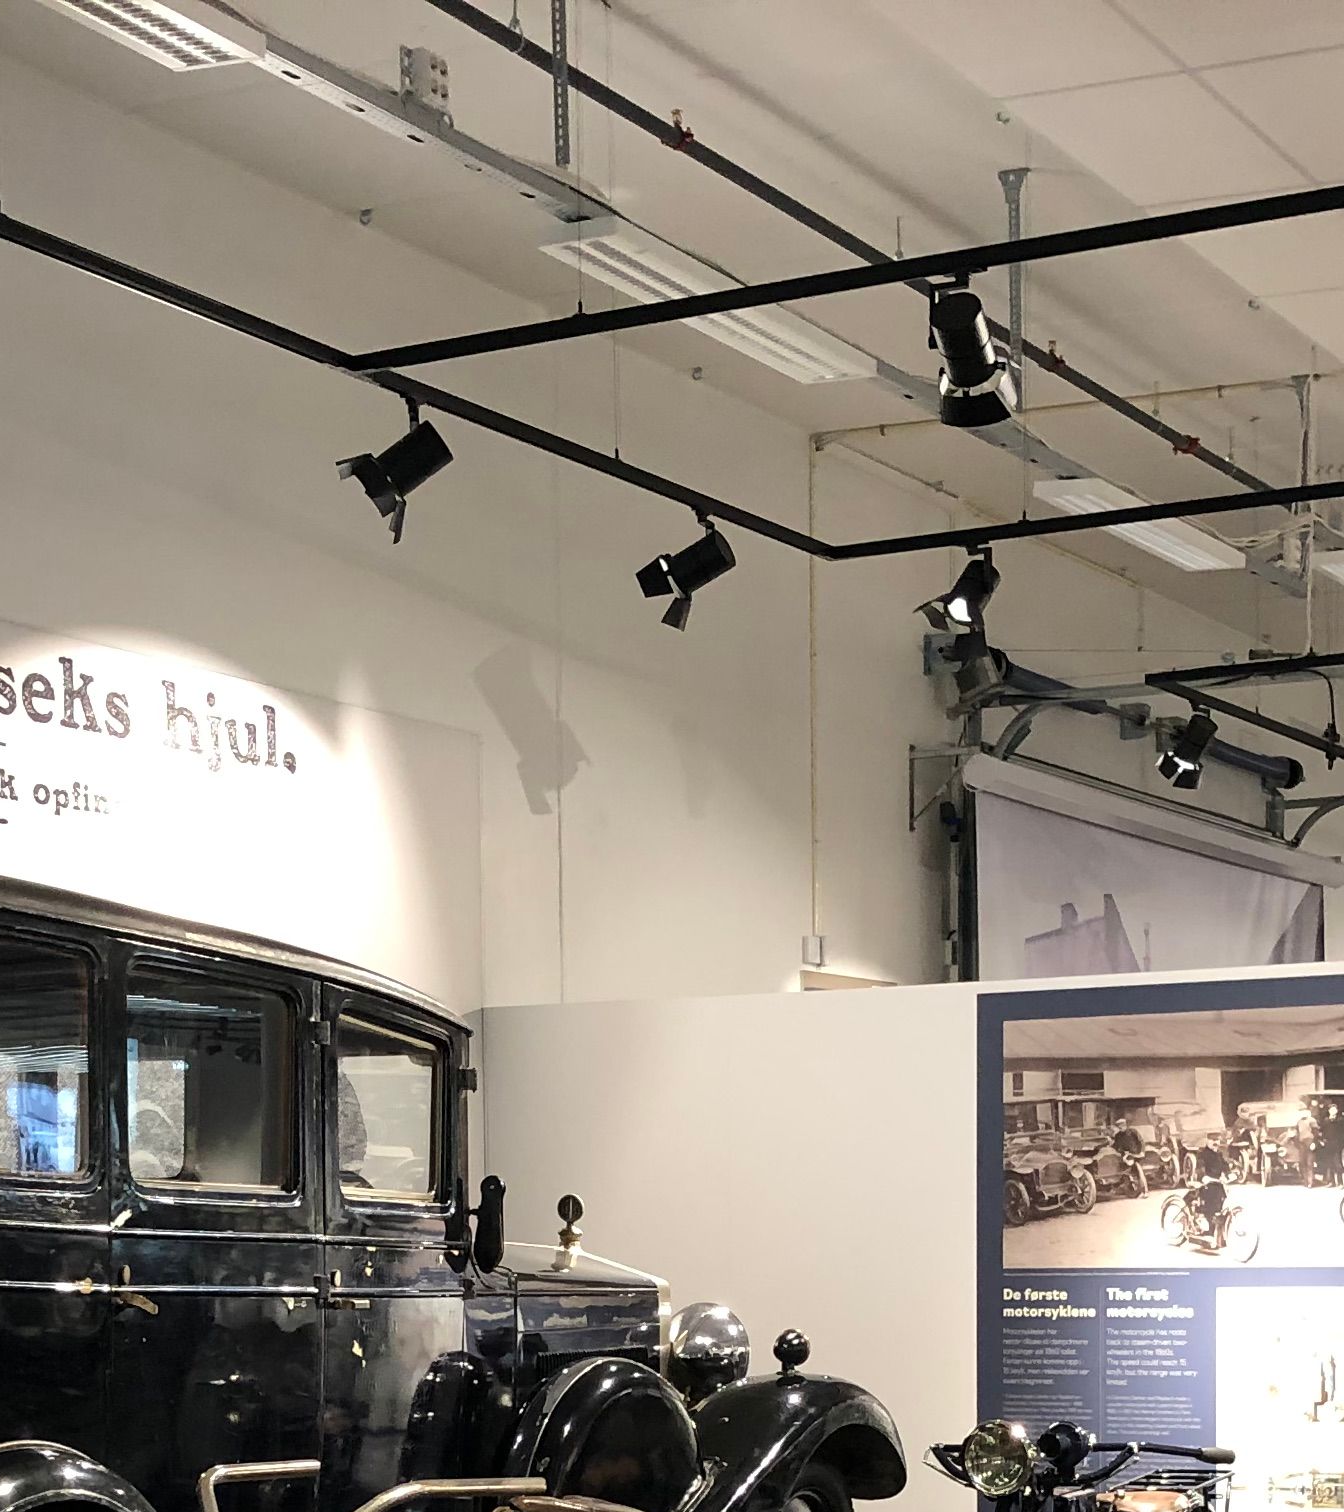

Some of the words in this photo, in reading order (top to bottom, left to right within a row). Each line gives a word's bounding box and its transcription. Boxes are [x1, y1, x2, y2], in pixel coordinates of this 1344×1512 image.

[162, 679, 296, 773] hjul.
[1002, 1288, 1022, 1301] De
[1024, 1288, 1068, 1301] første
[1106, 1287, 1133, 1301] The
[1135, 1287, 1169, 1301] first
[1002, 1305, 1097, 1321] motorsyklene
